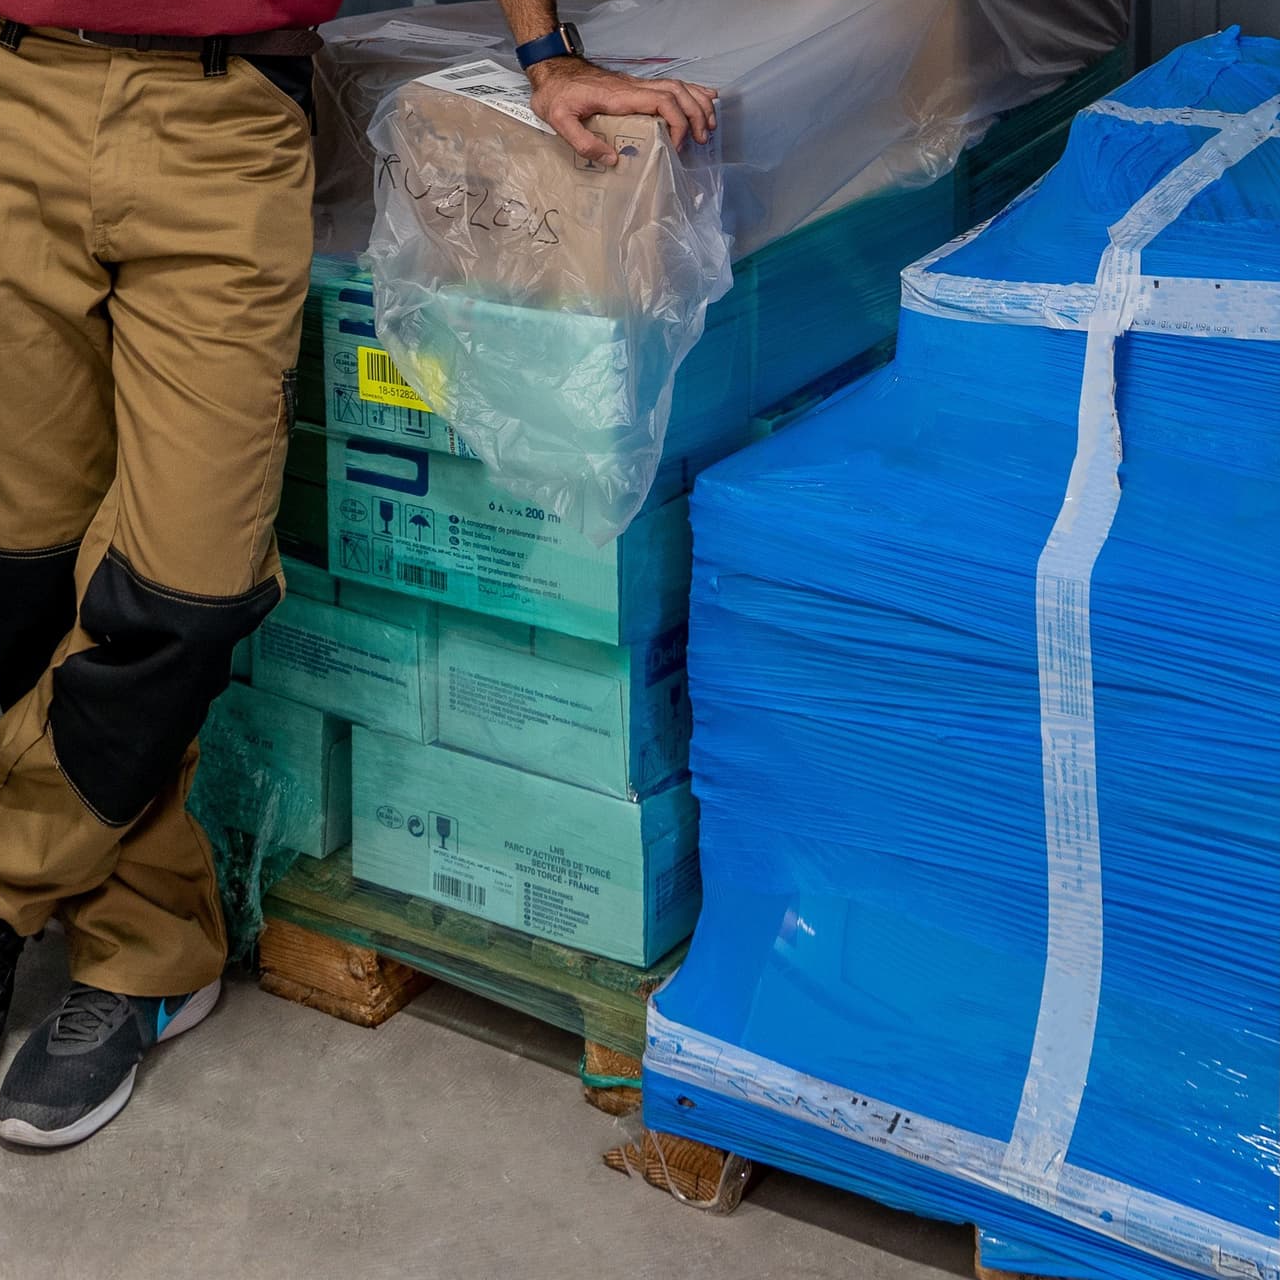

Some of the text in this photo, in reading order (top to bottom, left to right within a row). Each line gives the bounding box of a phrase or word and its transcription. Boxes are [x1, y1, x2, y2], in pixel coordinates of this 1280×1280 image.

[525, 507, 545, 521] 200
[504, 840, 525, 854] PARC
[572, 862, 584, 872] DE
[584, 864, 612, 880] TORCÉ
[549, 844, 565, 857] LNS
[531, 858, 567, 876] SECTEUR
[568, 870, 583, 881] EST
[537, 869, 563, 884] TORCÉ
[568, 879, 600, 896] FRANCE
